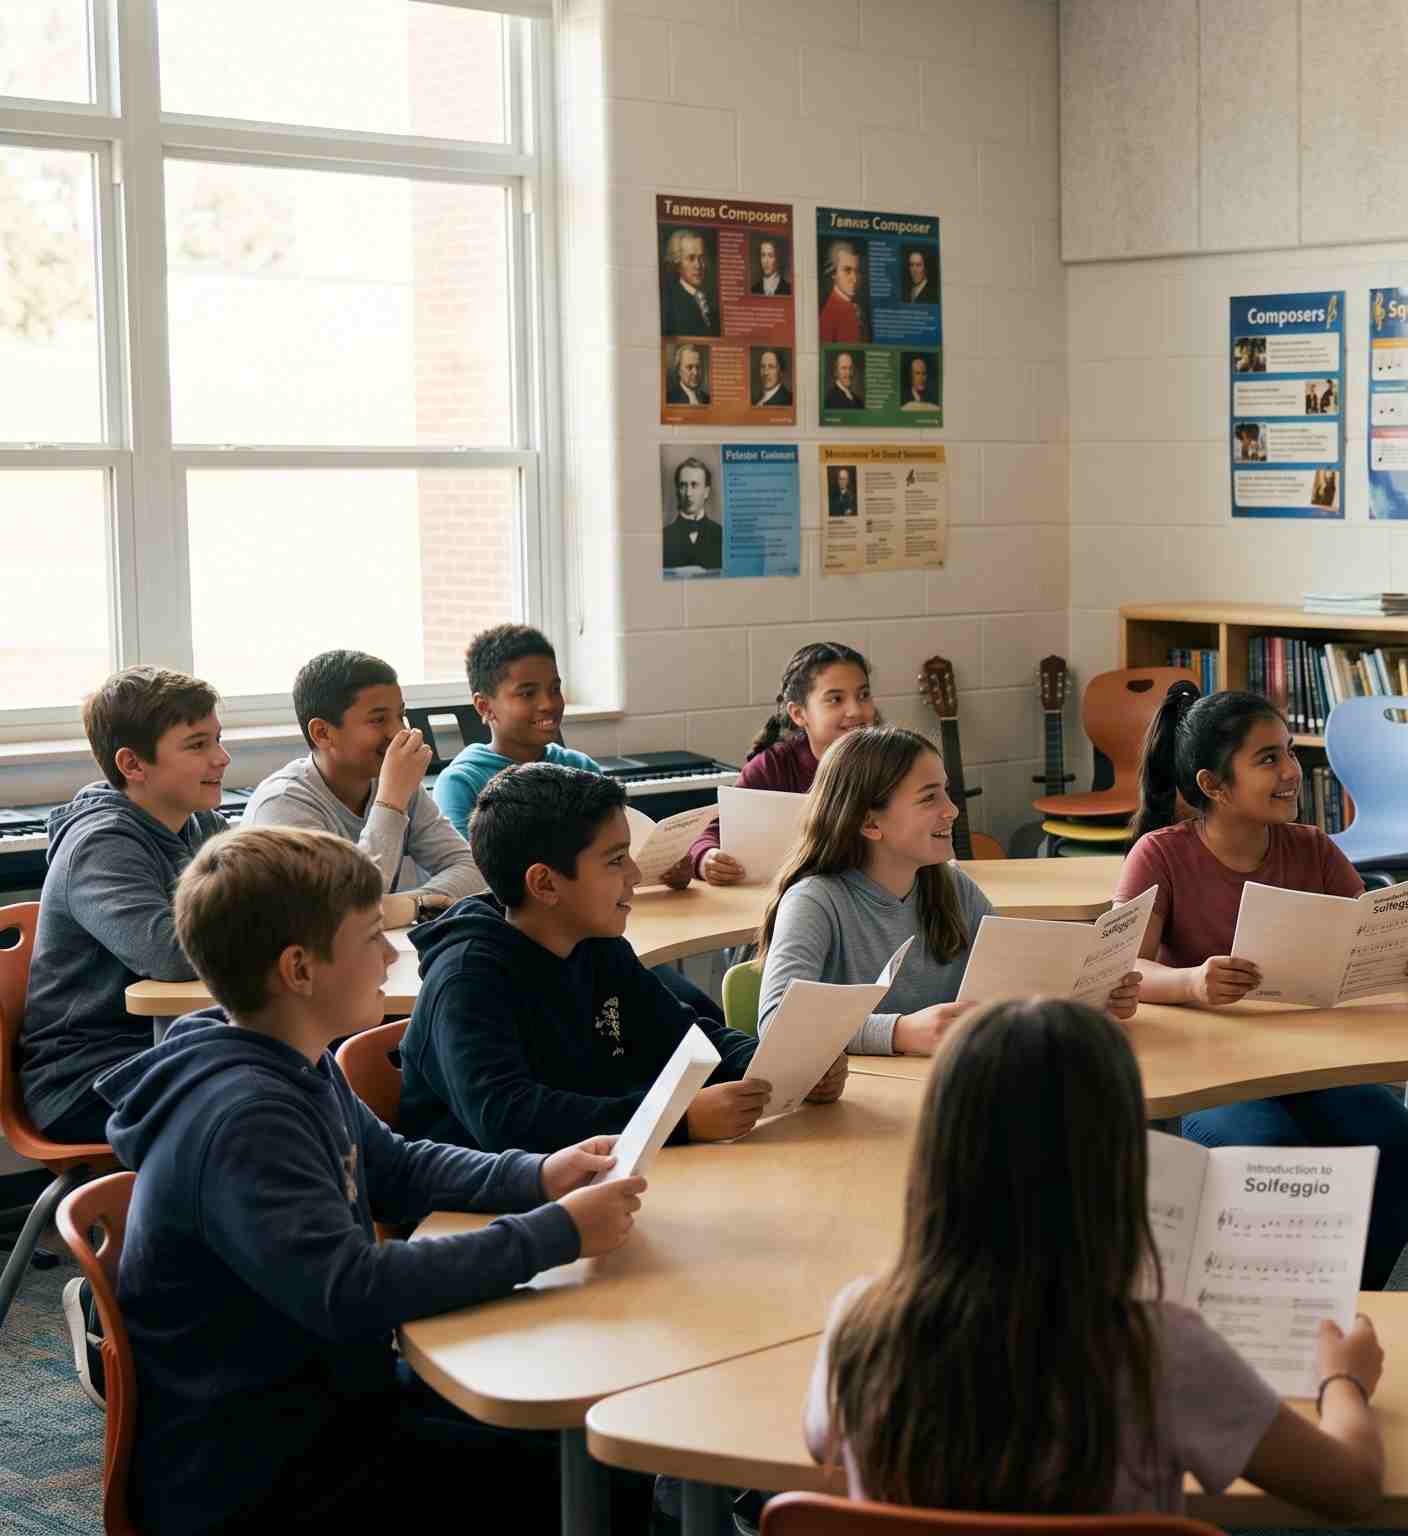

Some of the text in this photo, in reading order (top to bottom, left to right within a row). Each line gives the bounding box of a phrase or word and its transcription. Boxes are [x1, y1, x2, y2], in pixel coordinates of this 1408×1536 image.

[719, 205, 788, 223] Composers
[1248, 307, 1325, 327] Composers
[1246, 1163, 1334, 1175] Introduction to
[1244, 1177, 1330, 1198] Solfeggio
